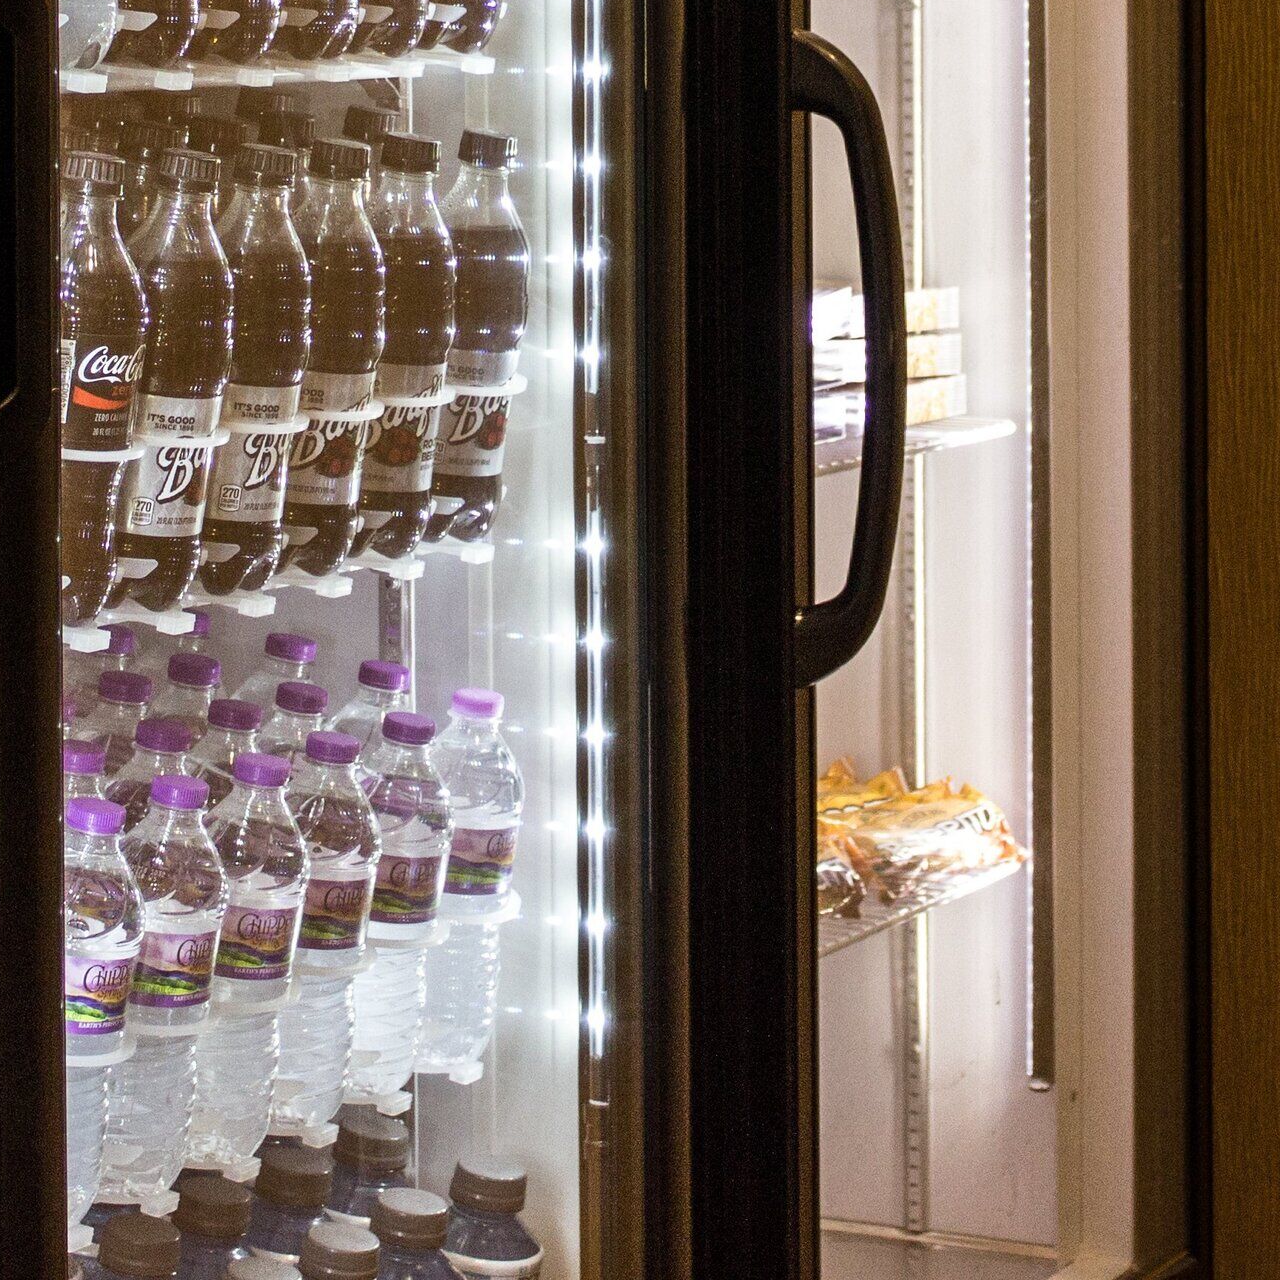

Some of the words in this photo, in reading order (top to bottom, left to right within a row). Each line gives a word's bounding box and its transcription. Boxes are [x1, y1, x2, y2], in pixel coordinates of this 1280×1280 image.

[254, 404, 279, 413] GOOD
[168, 415, 195, 425] GOOD
[222, 487, 240, 499] 270
